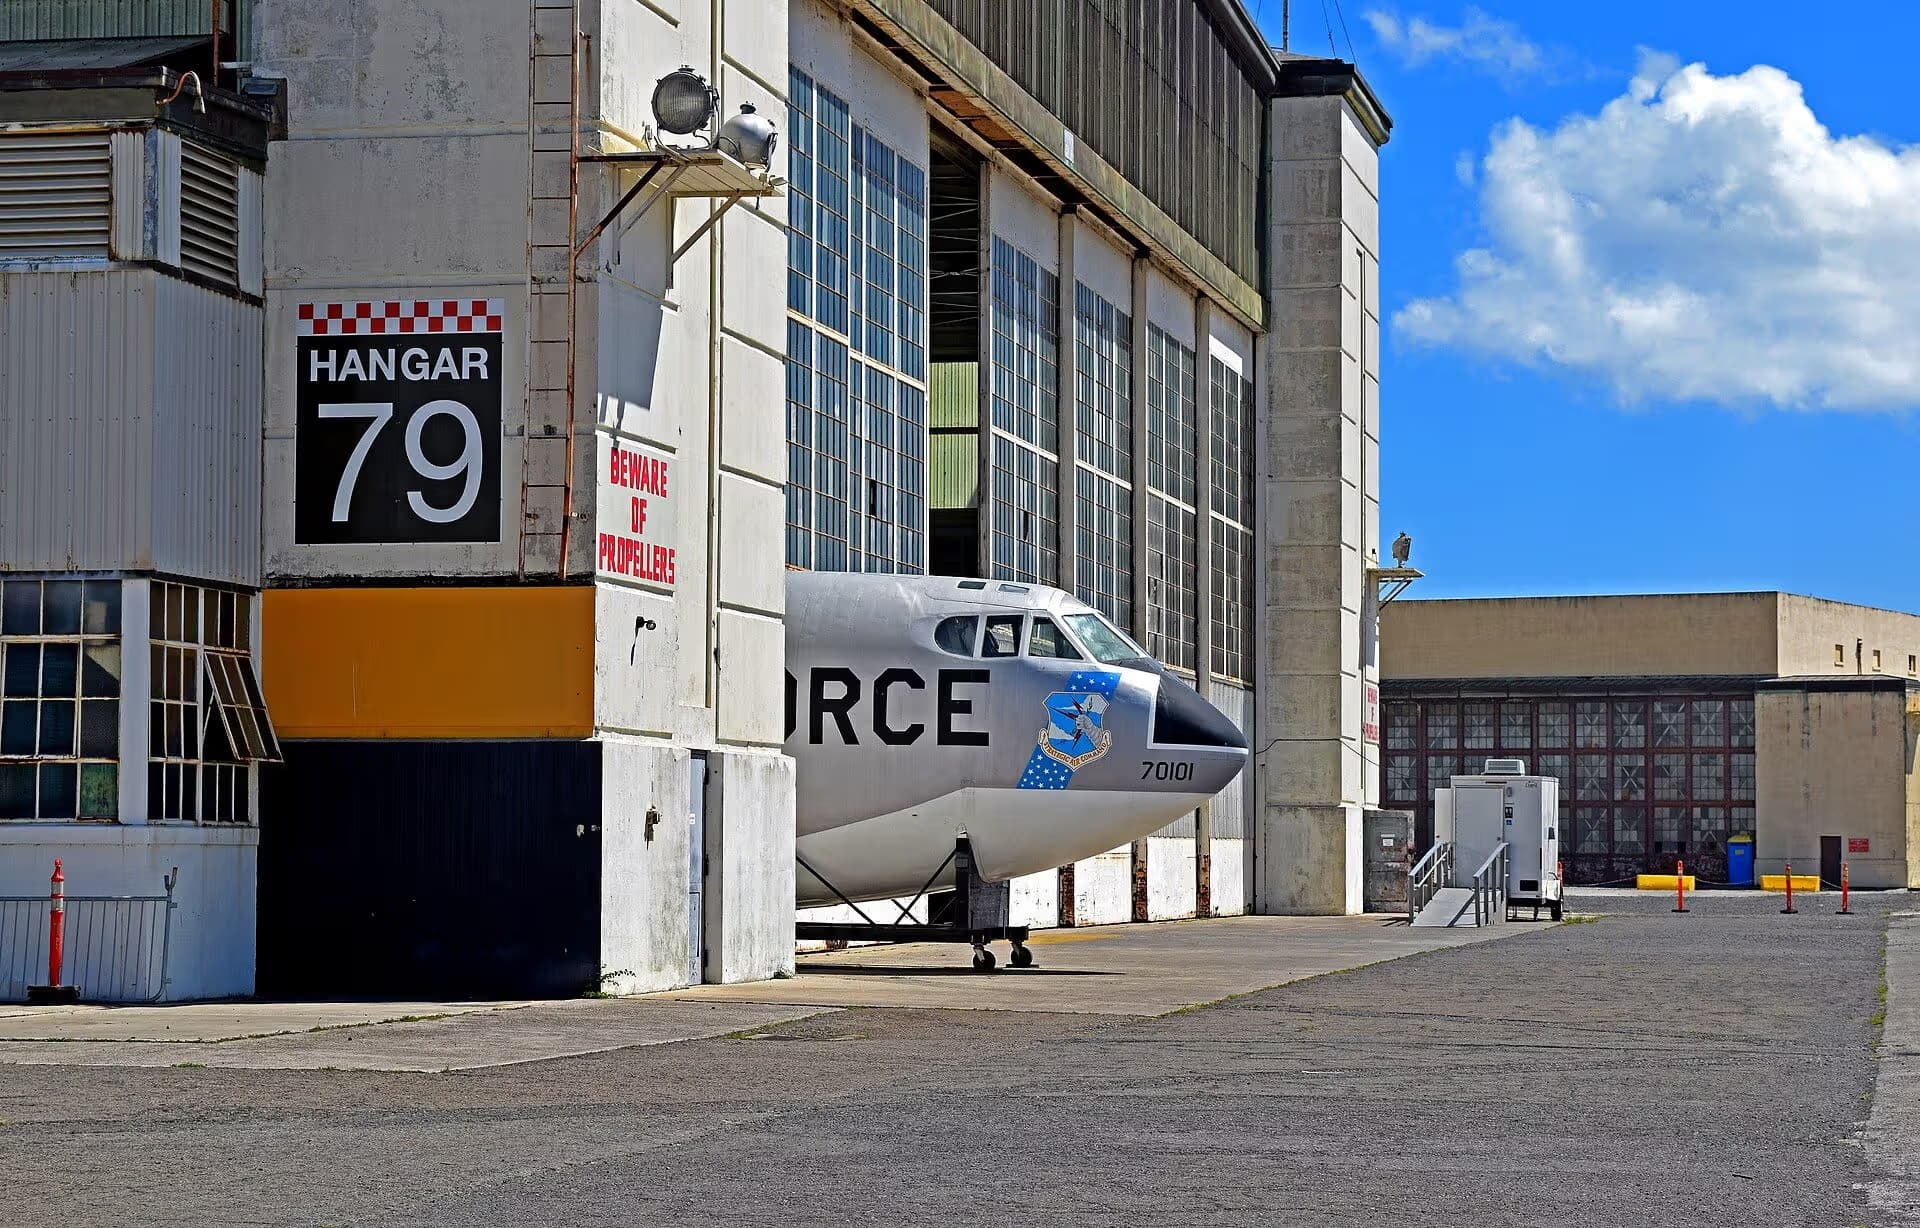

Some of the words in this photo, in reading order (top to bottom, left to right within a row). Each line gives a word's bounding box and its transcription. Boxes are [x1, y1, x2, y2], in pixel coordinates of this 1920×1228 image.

[310, 347, 488, 381] HANGAR
[318, 400, 483, 523] 79
[610, 447, 667, 498] BEWARE
[631, 496, 647, 534] OF
[599, 532, 675, 584] PROPELLERS
[784, 667, 990, 746] RCE
[1069, 758, 1080, 767] AIR
[1141, 761, 1194, 780] 70101
